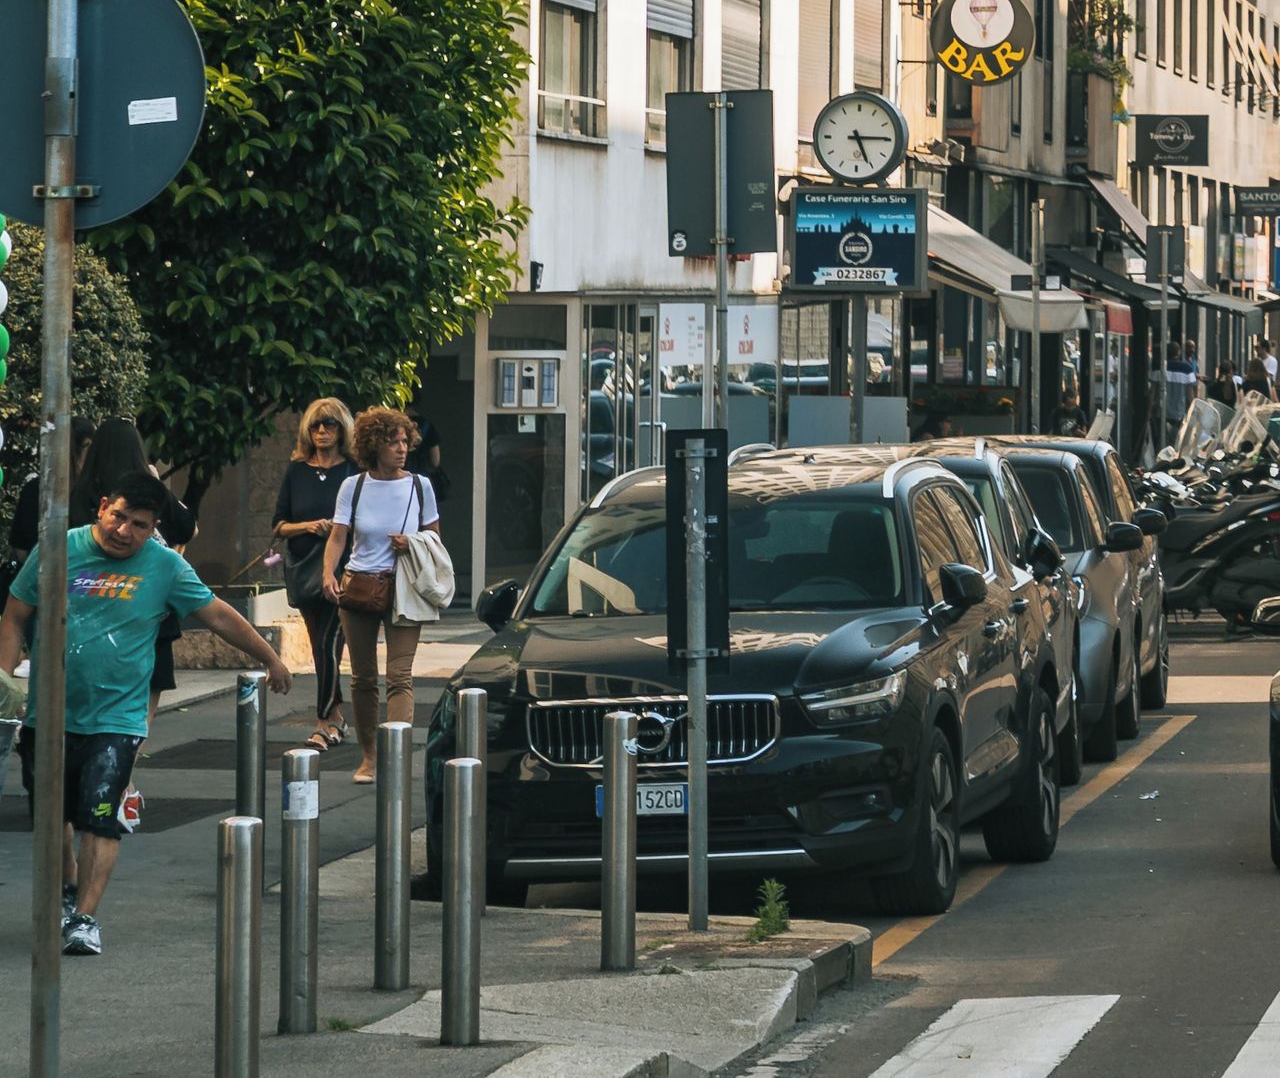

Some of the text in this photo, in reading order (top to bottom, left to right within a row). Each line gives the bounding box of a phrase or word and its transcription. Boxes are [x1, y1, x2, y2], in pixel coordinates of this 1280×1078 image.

[938, 38, 1025, 81] BAR
[805, 194, 907, 203] Case Funerarie San Siro
[836, 269, 886, 280] 0232867
